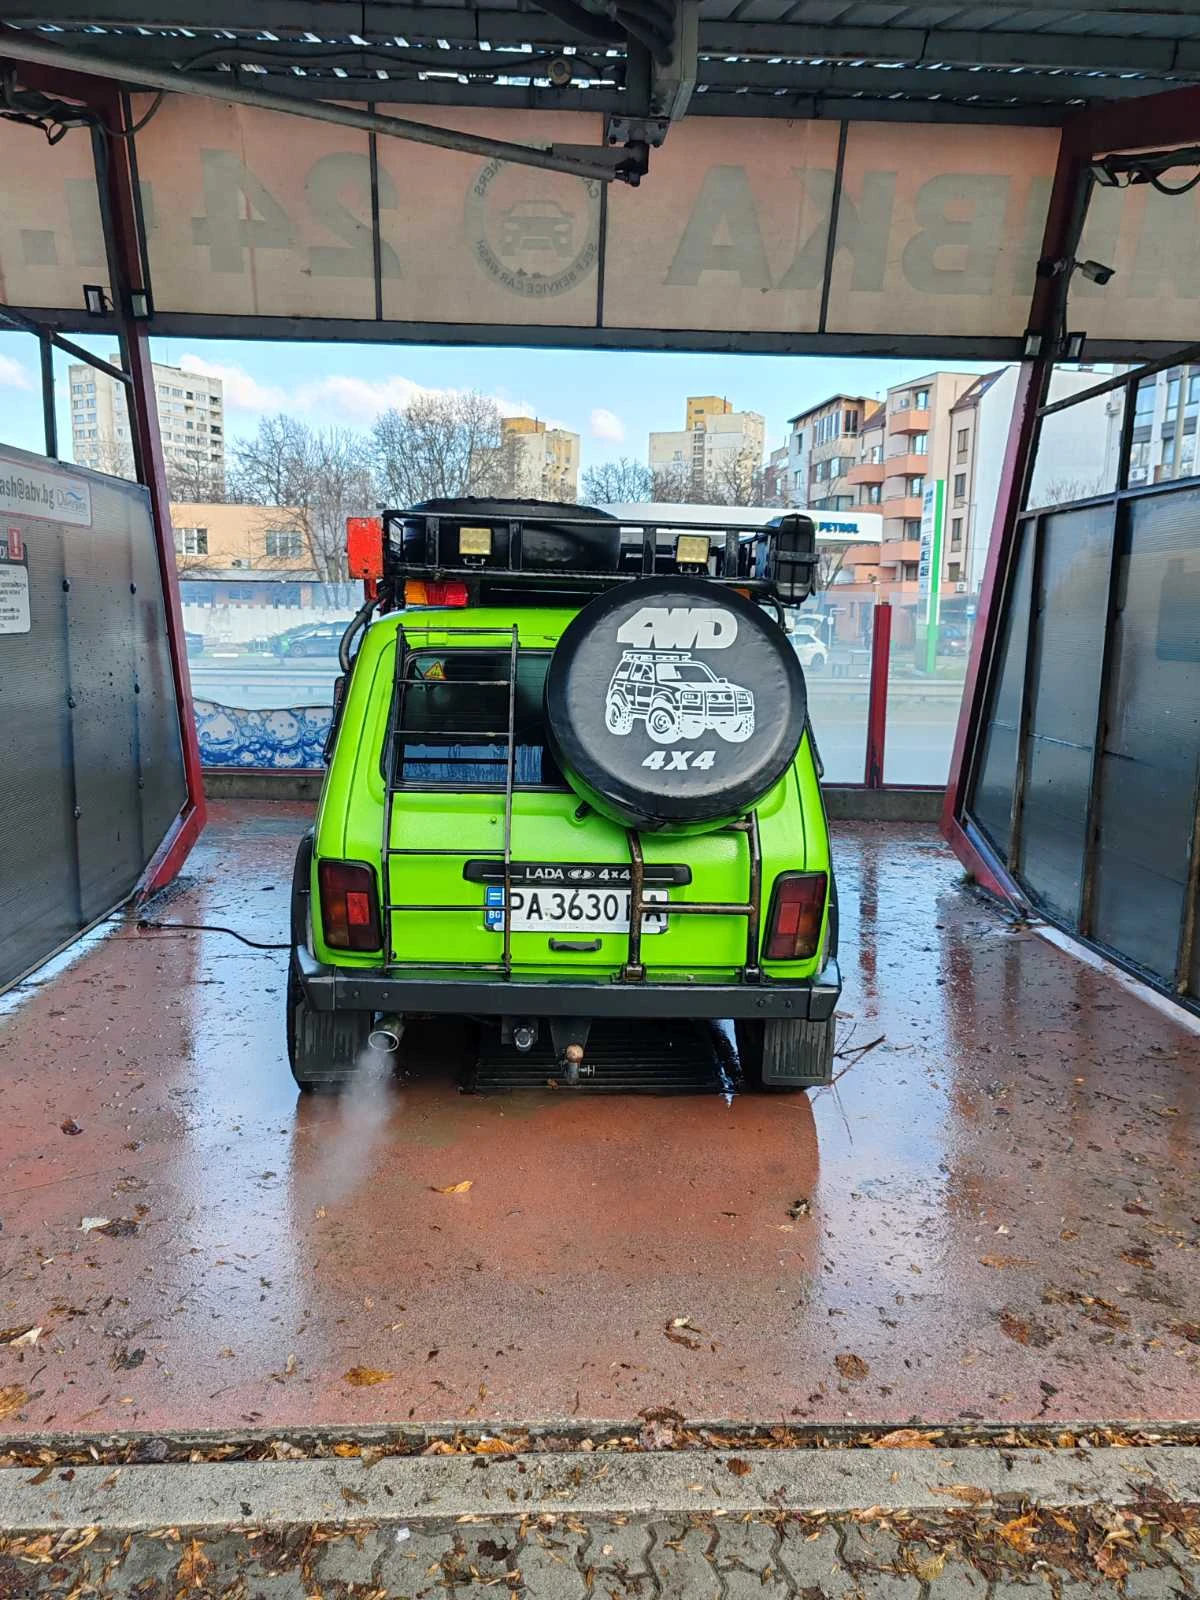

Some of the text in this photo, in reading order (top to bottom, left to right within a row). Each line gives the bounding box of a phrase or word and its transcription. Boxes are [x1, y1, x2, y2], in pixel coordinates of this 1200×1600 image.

[819, 522, 859, 533] PETROL
[616, 608, 738, 649] 4WD
[641, 750, 717, 771] 4X4
[526, 867, 564, 880] LADA
[550, 892, 619, 921] 3630
